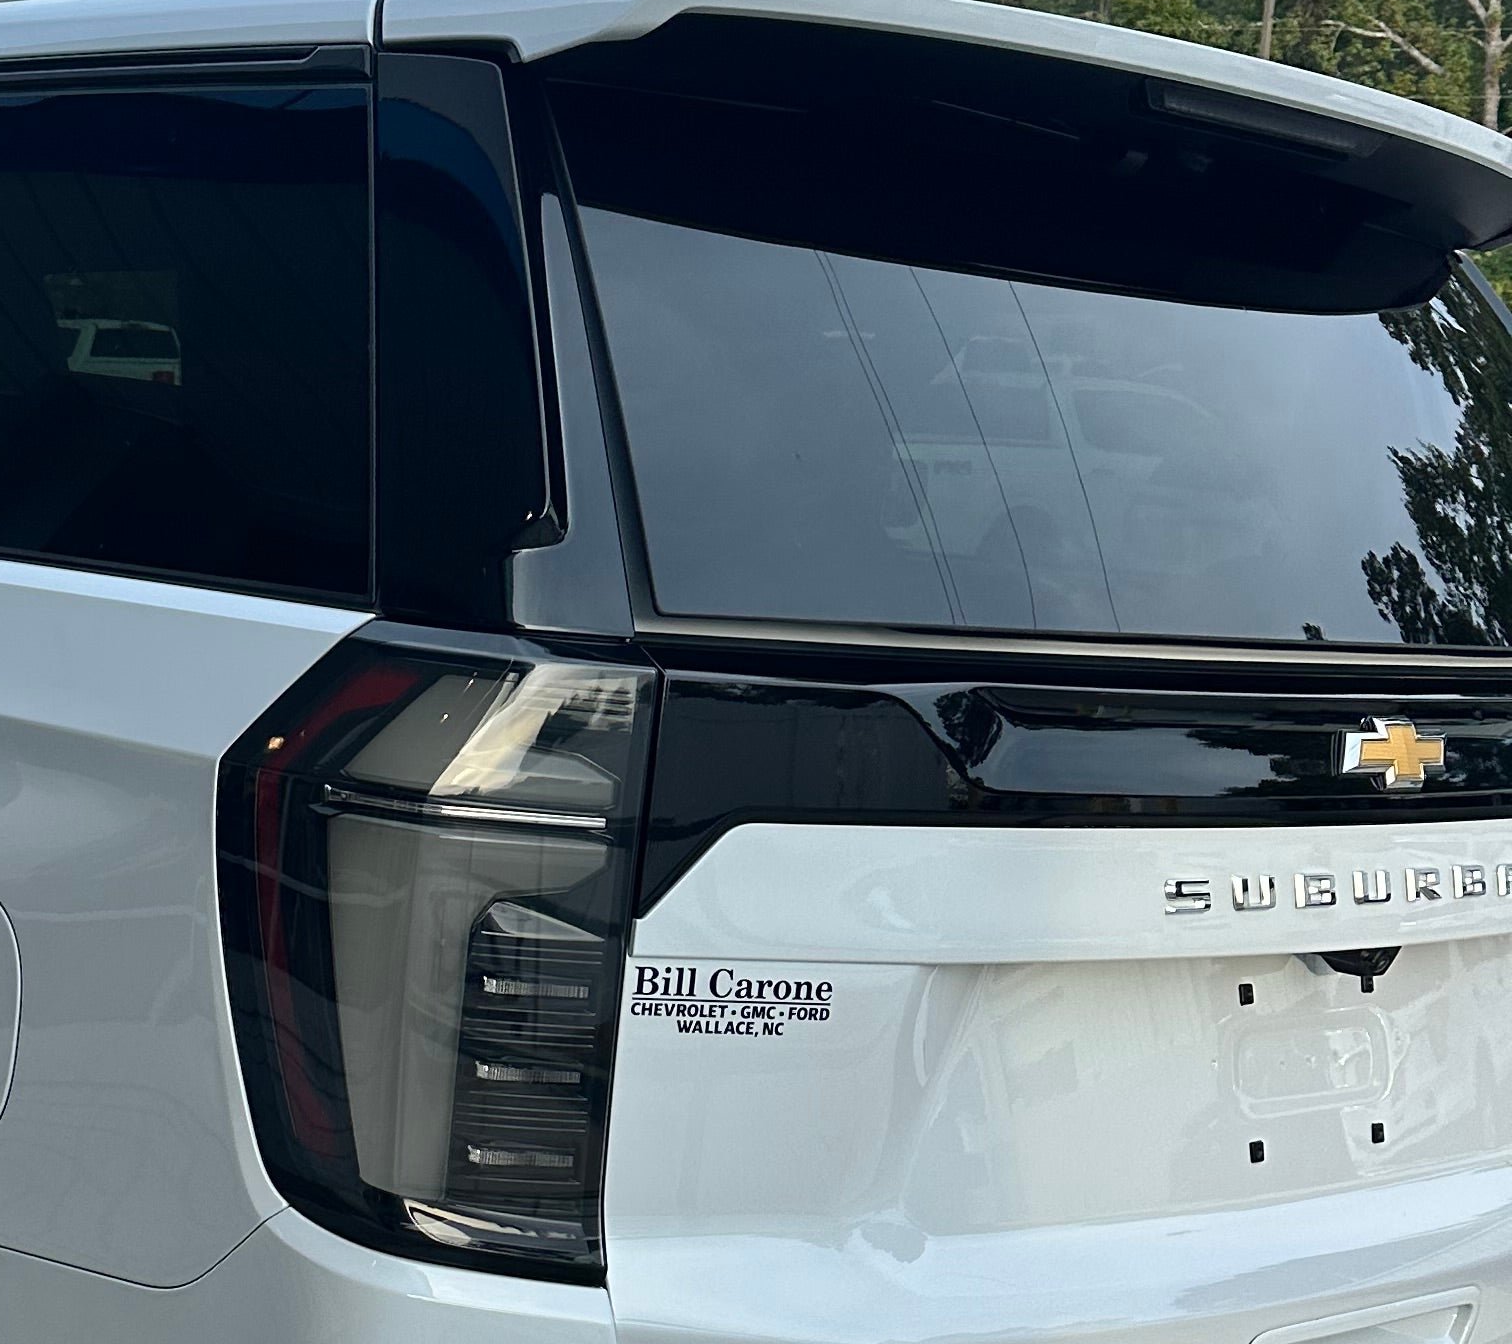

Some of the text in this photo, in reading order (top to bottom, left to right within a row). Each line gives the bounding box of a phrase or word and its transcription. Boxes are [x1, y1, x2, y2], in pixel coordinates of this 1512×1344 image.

[632, 965, 834, 1002] Bill Carone
[630, 1001, 830, 1022] CHEVROLET GMC FORD
[676, 1019, 785, 1037] WALLACE, NC
